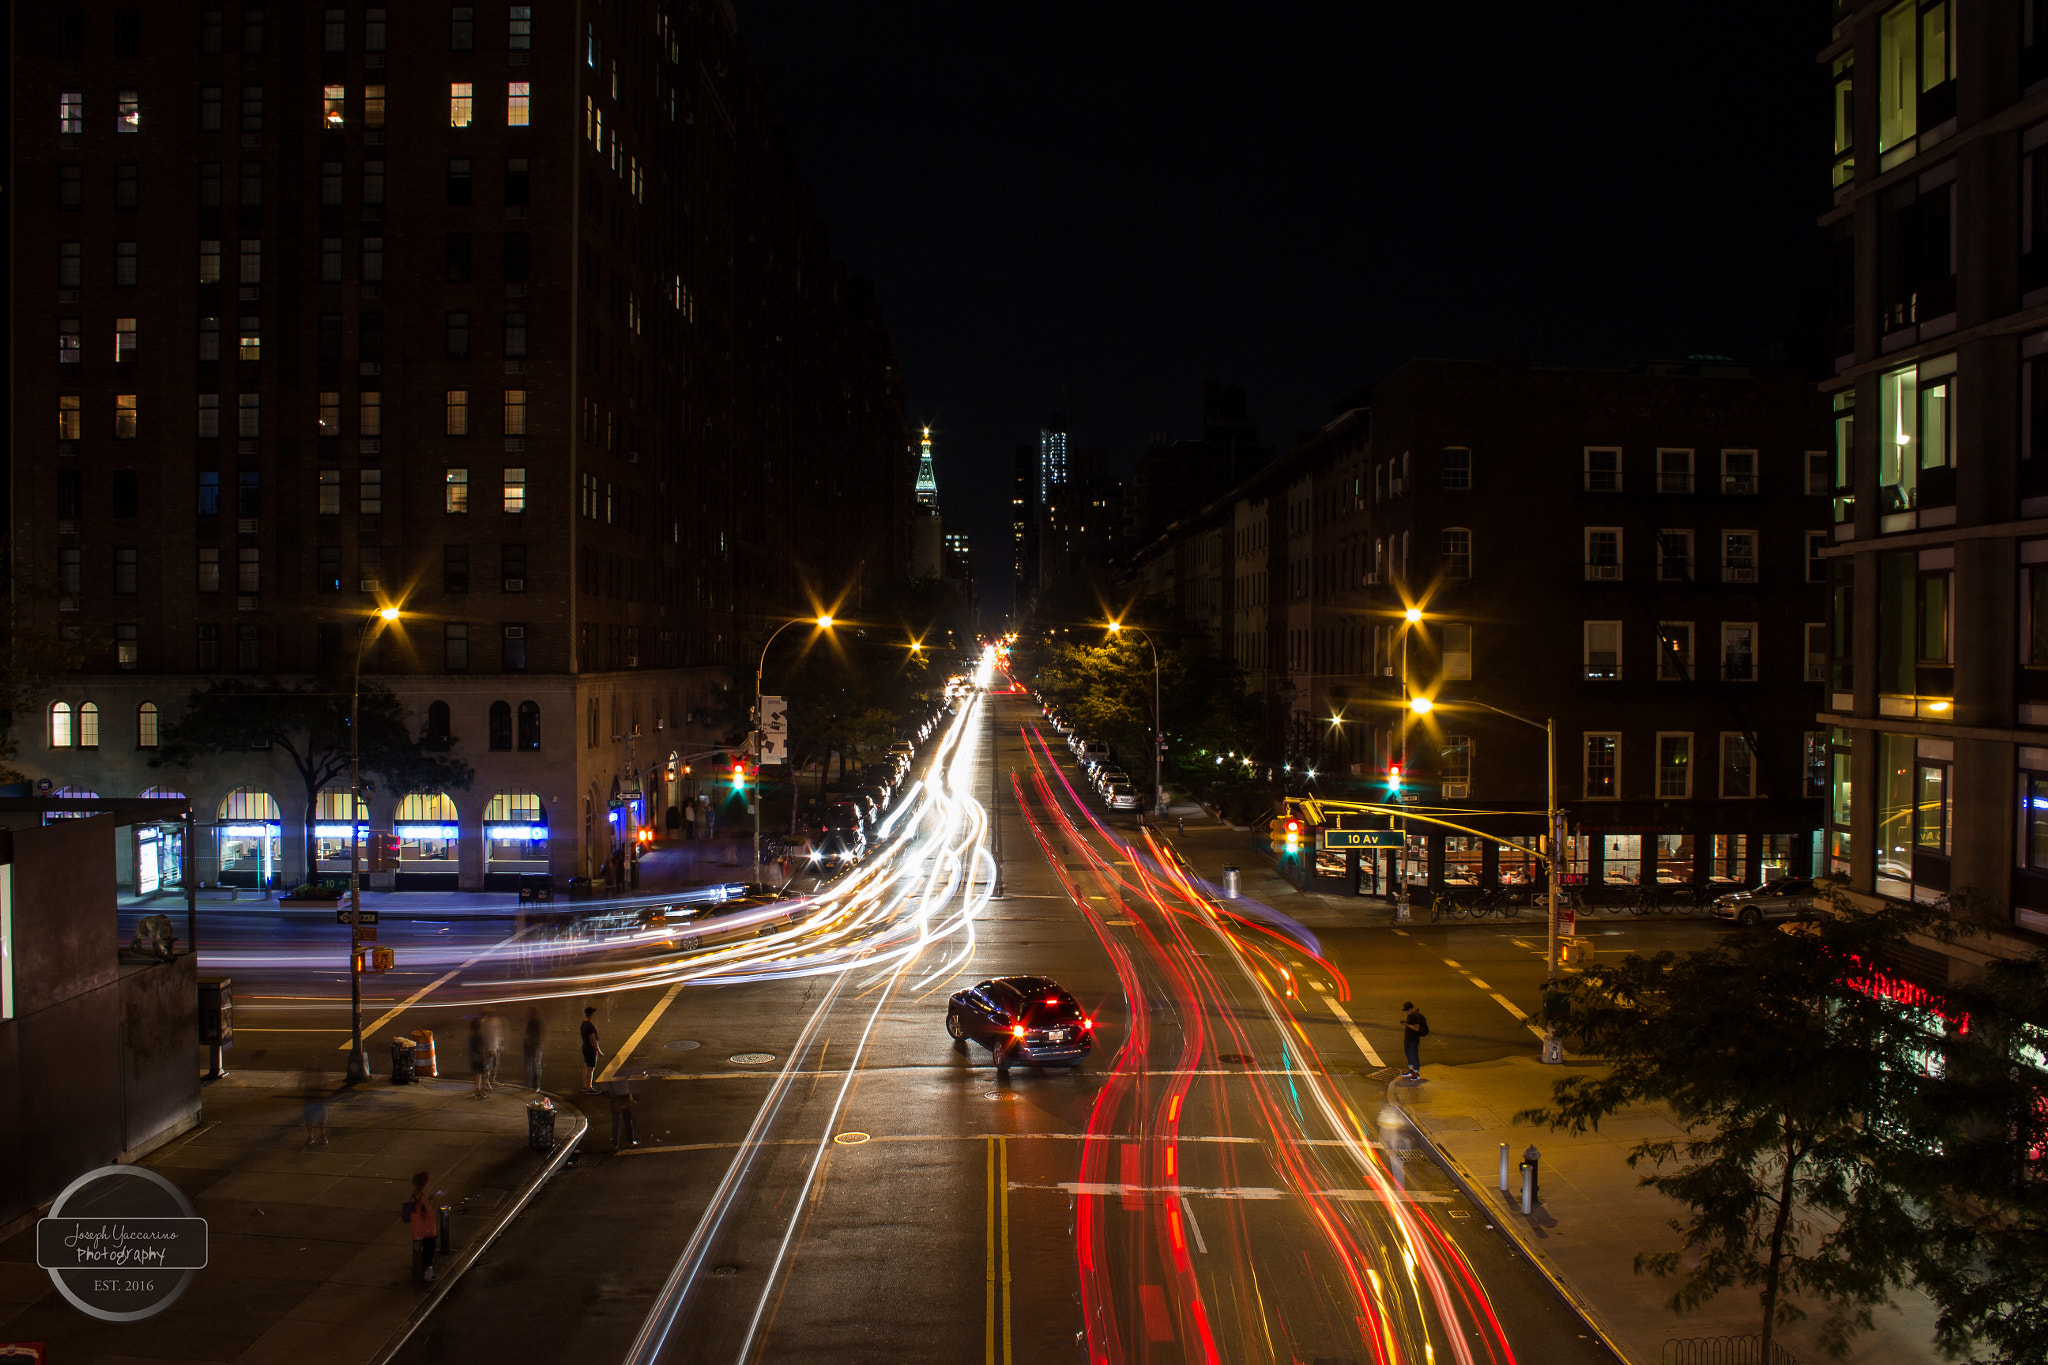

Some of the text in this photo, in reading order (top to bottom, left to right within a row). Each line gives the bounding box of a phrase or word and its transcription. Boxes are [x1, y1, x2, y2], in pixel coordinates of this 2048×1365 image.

[1348, 834, 1379, 844] 10 Av
[325, 879, 335, 888] 10
